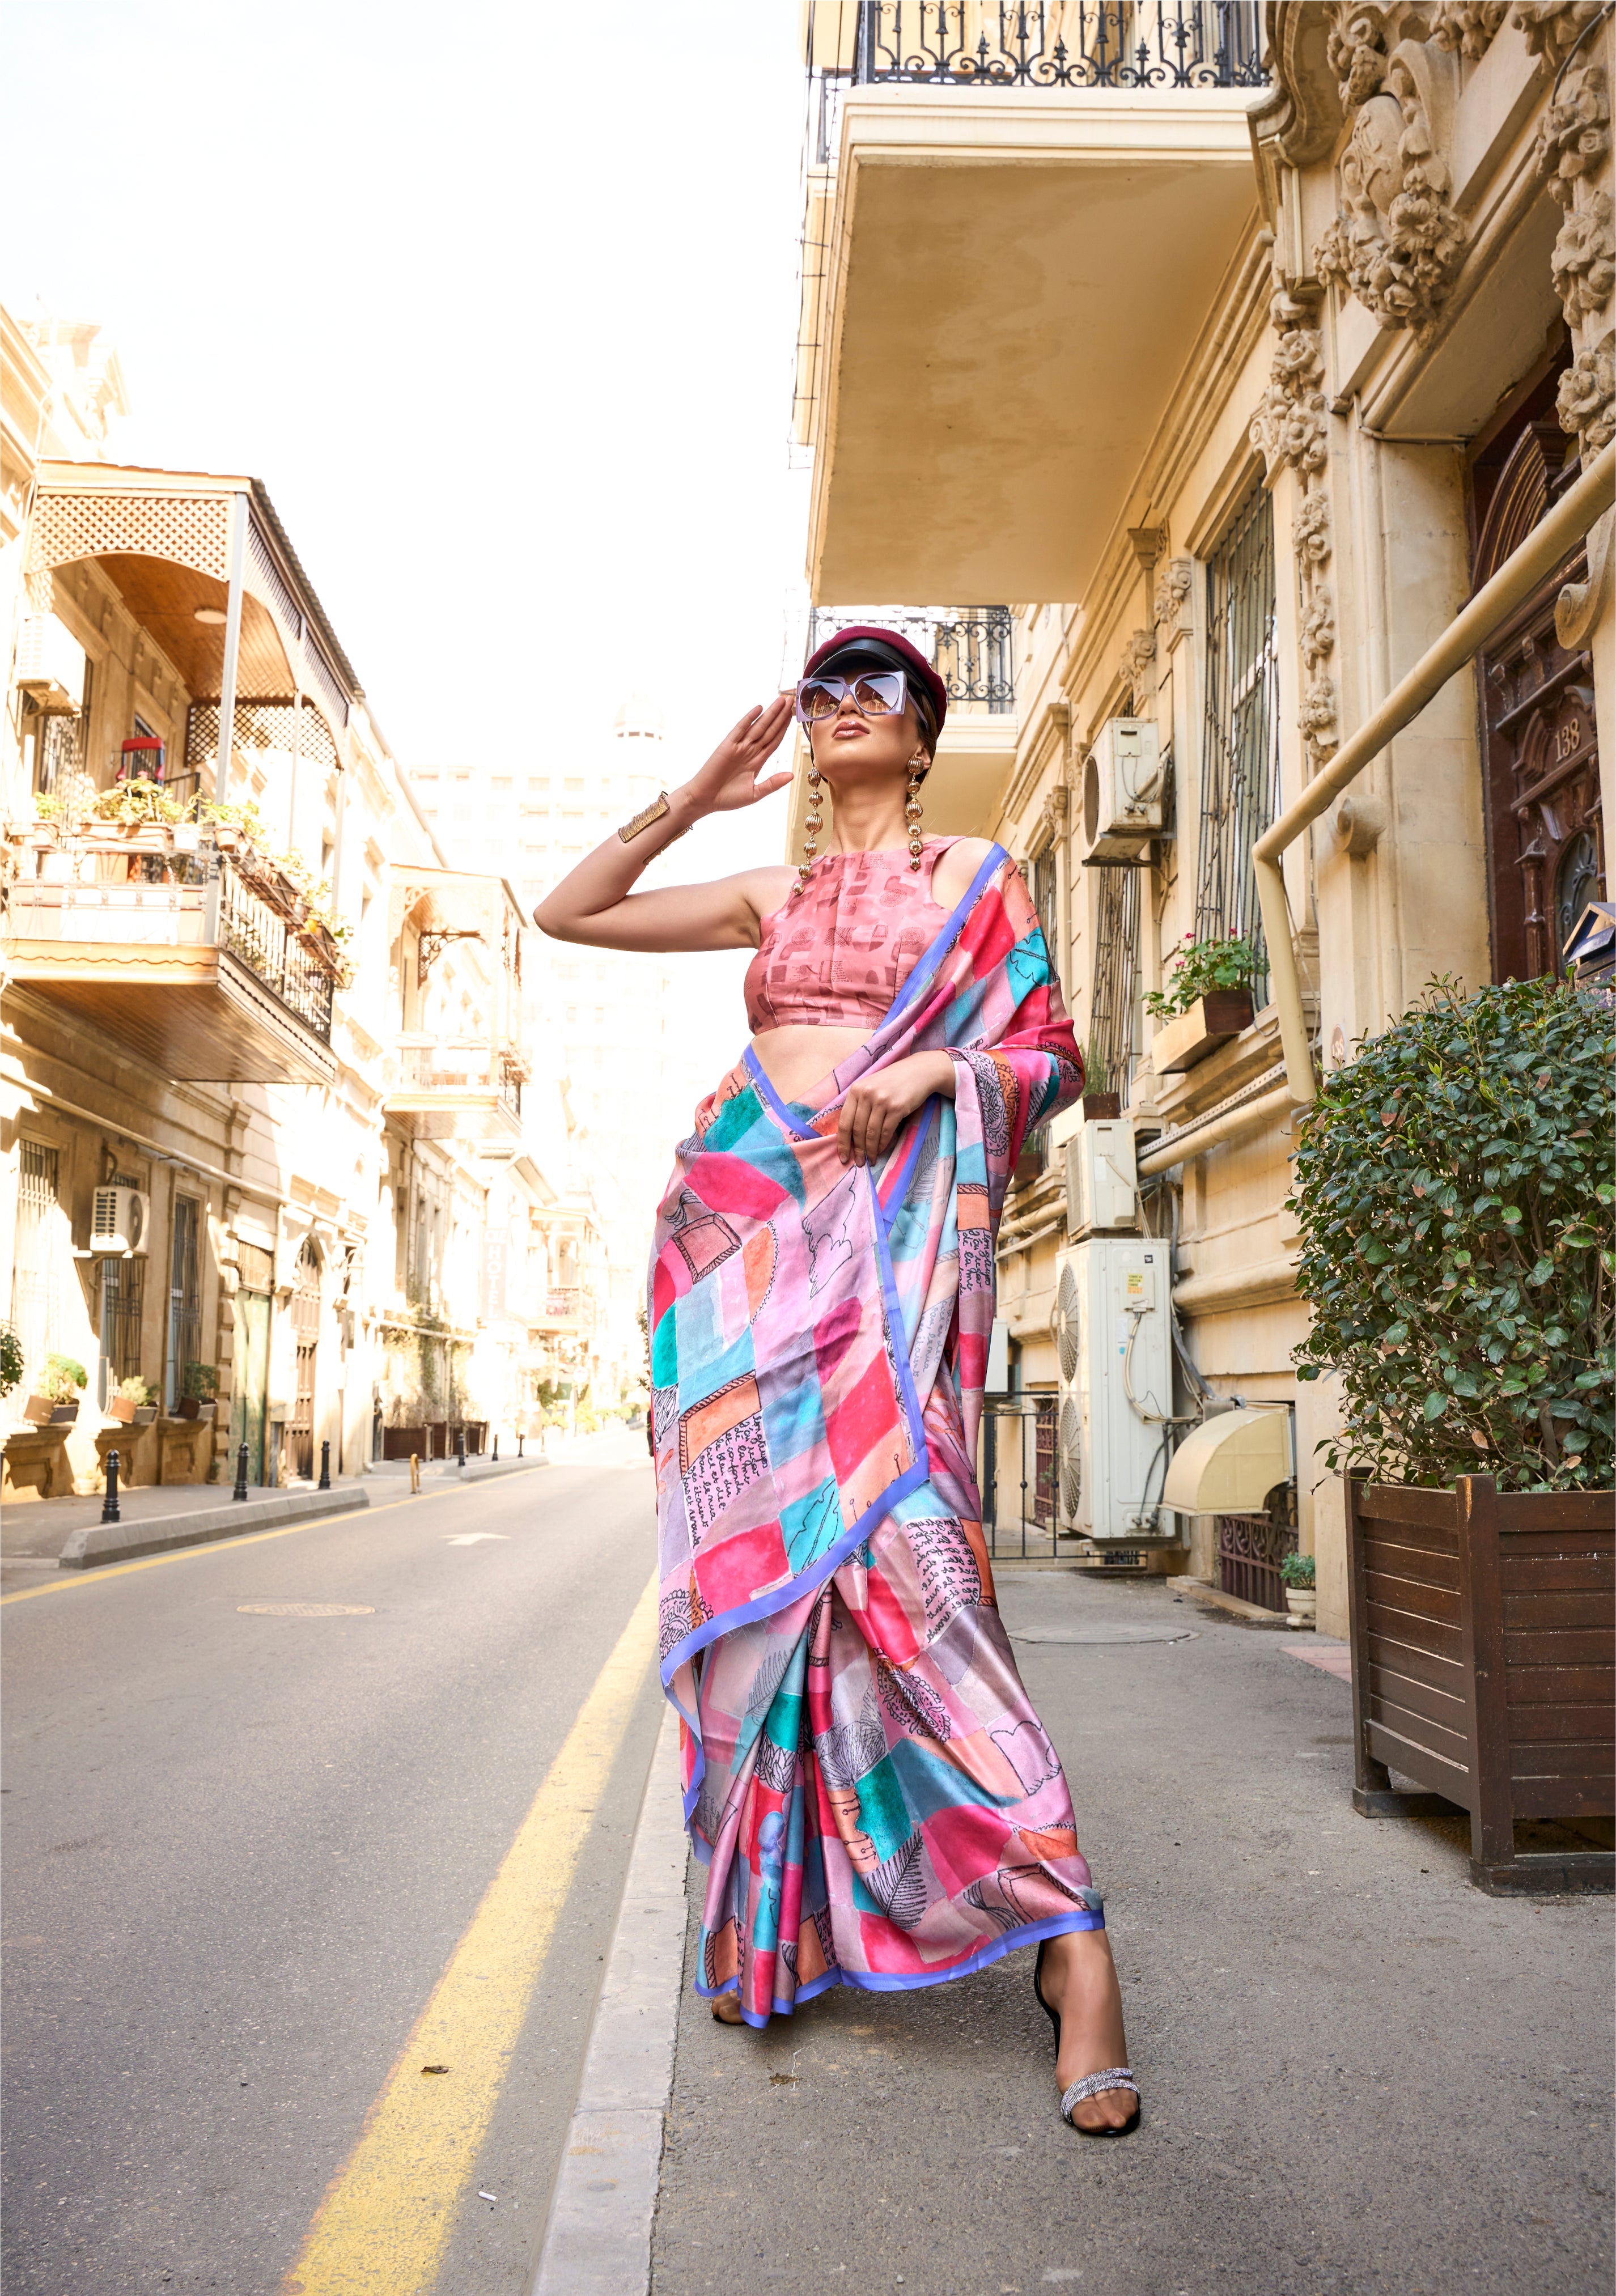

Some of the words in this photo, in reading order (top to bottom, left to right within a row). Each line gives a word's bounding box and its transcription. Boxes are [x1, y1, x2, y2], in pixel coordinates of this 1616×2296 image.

[1555, 718, 1579, 762] 138
[1332, 1037, 1344, 1058] 138
[487, 1245, 502, 1319] HOTEL
